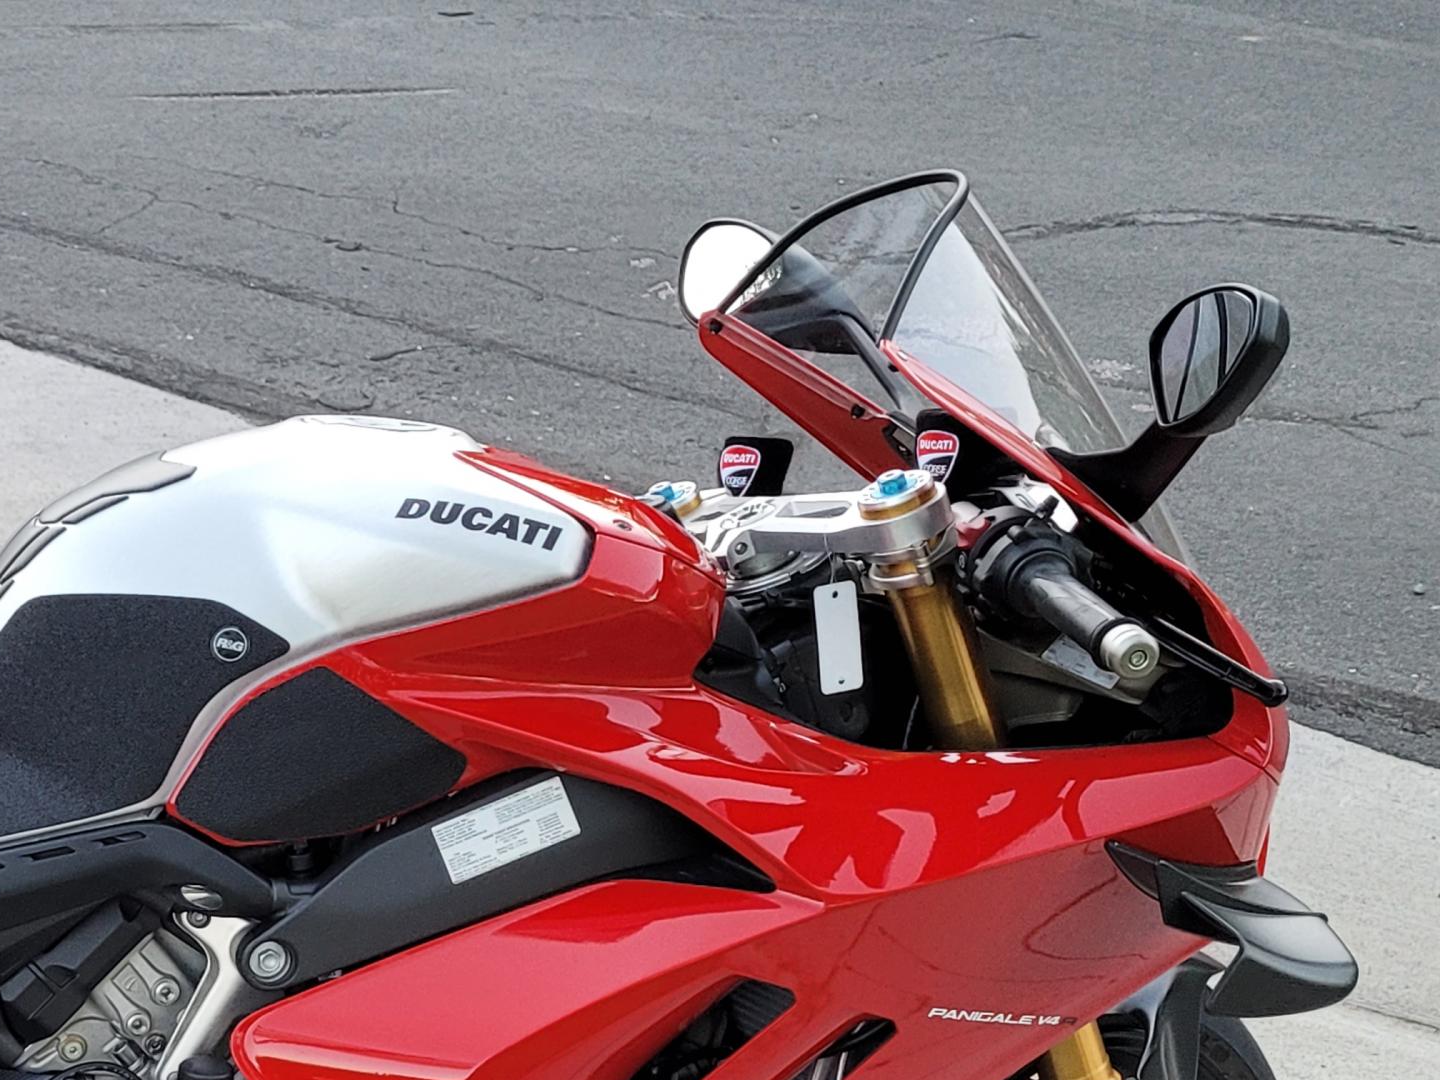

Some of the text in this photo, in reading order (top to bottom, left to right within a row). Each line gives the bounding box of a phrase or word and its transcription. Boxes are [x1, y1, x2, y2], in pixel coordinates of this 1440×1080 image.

[920, 439, 953, 450] DUCATI
[723, 453, 756, 464] DUCATI
[395, 498, 563, 551] DUCATI
[216, 637, 245, 652] R&G
[928, 1007, 1036, 1025] PANIGALE
[1037, 1015, 1061, 1026] V4
